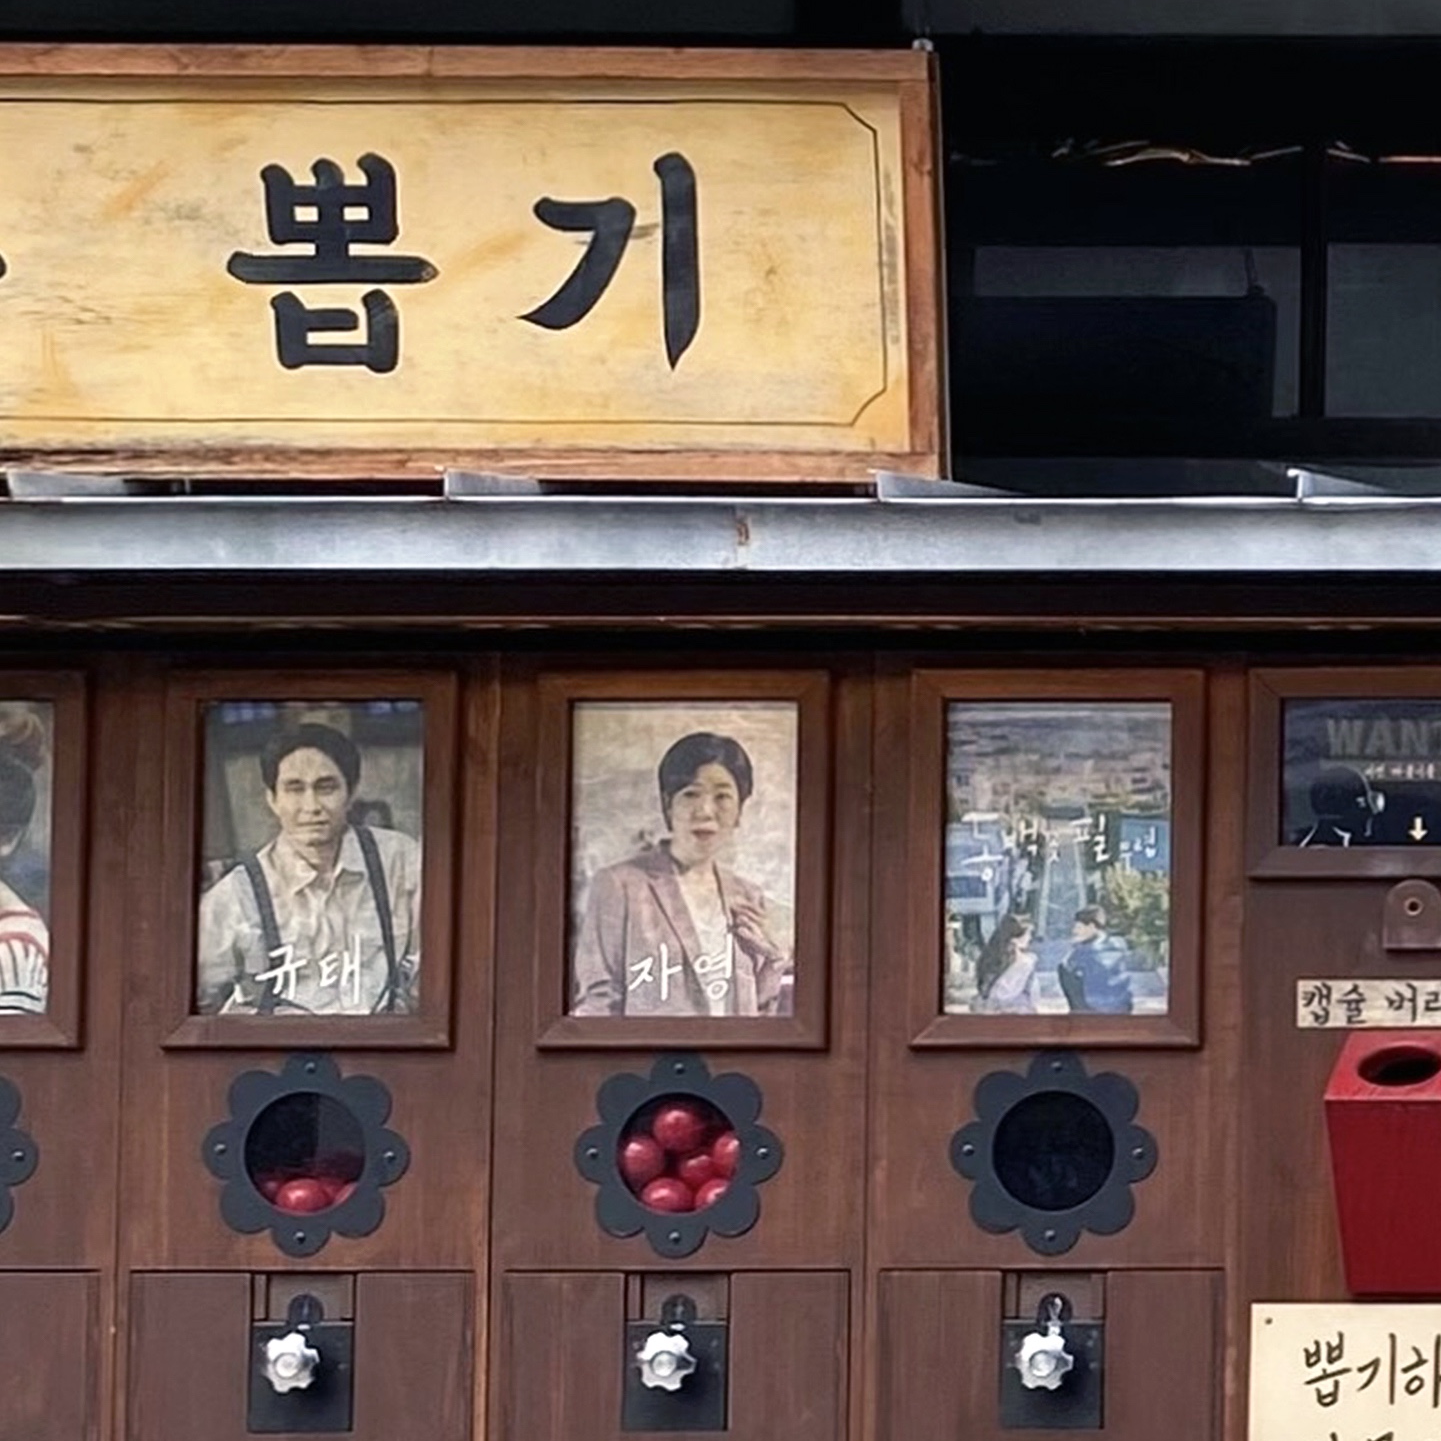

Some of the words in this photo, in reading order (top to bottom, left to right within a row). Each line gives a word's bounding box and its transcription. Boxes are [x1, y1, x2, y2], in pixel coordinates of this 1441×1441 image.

[226, 152, 701, 374] 뽑기
[254, 934, 363, 1006] 규태
[627, 931, 737, 1005] 자영
[1300, 983, 1368, 1024] 캡슐
